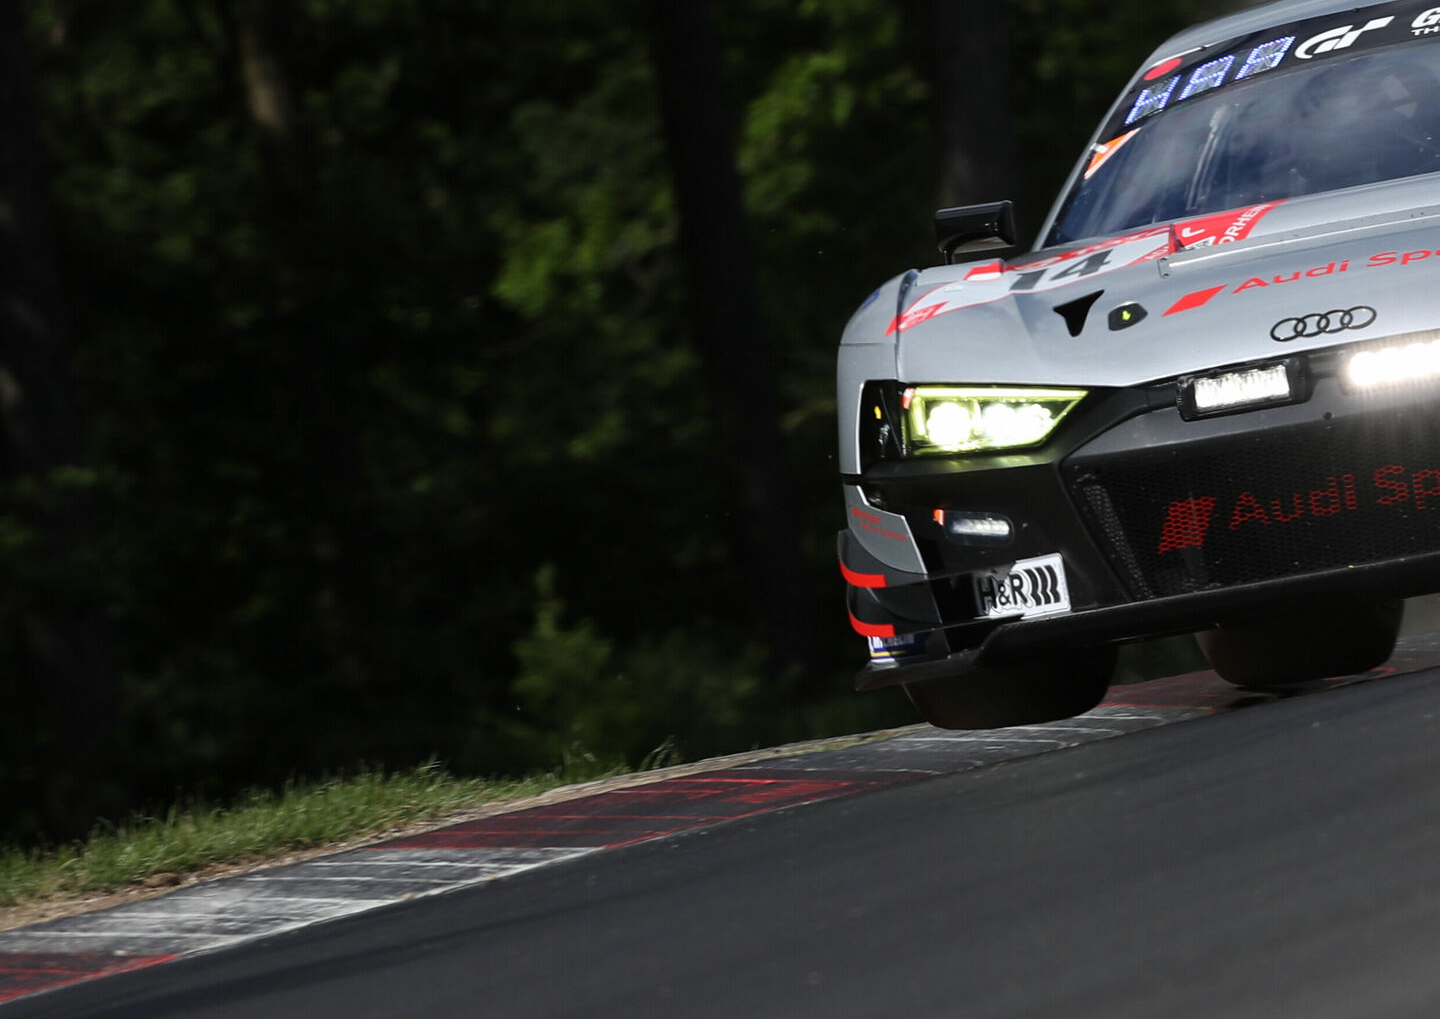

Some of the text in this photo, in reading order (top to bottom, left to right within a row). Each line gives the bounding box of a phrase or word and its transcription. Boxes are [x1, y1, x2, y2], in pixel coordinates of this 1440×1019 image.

[1009, 249, 1113, 292] 14
[1231, 260, 1351, 296] Audi
[1229, 473, 1358, 531] Audi
[979, 572, 1029, 613] H&R
